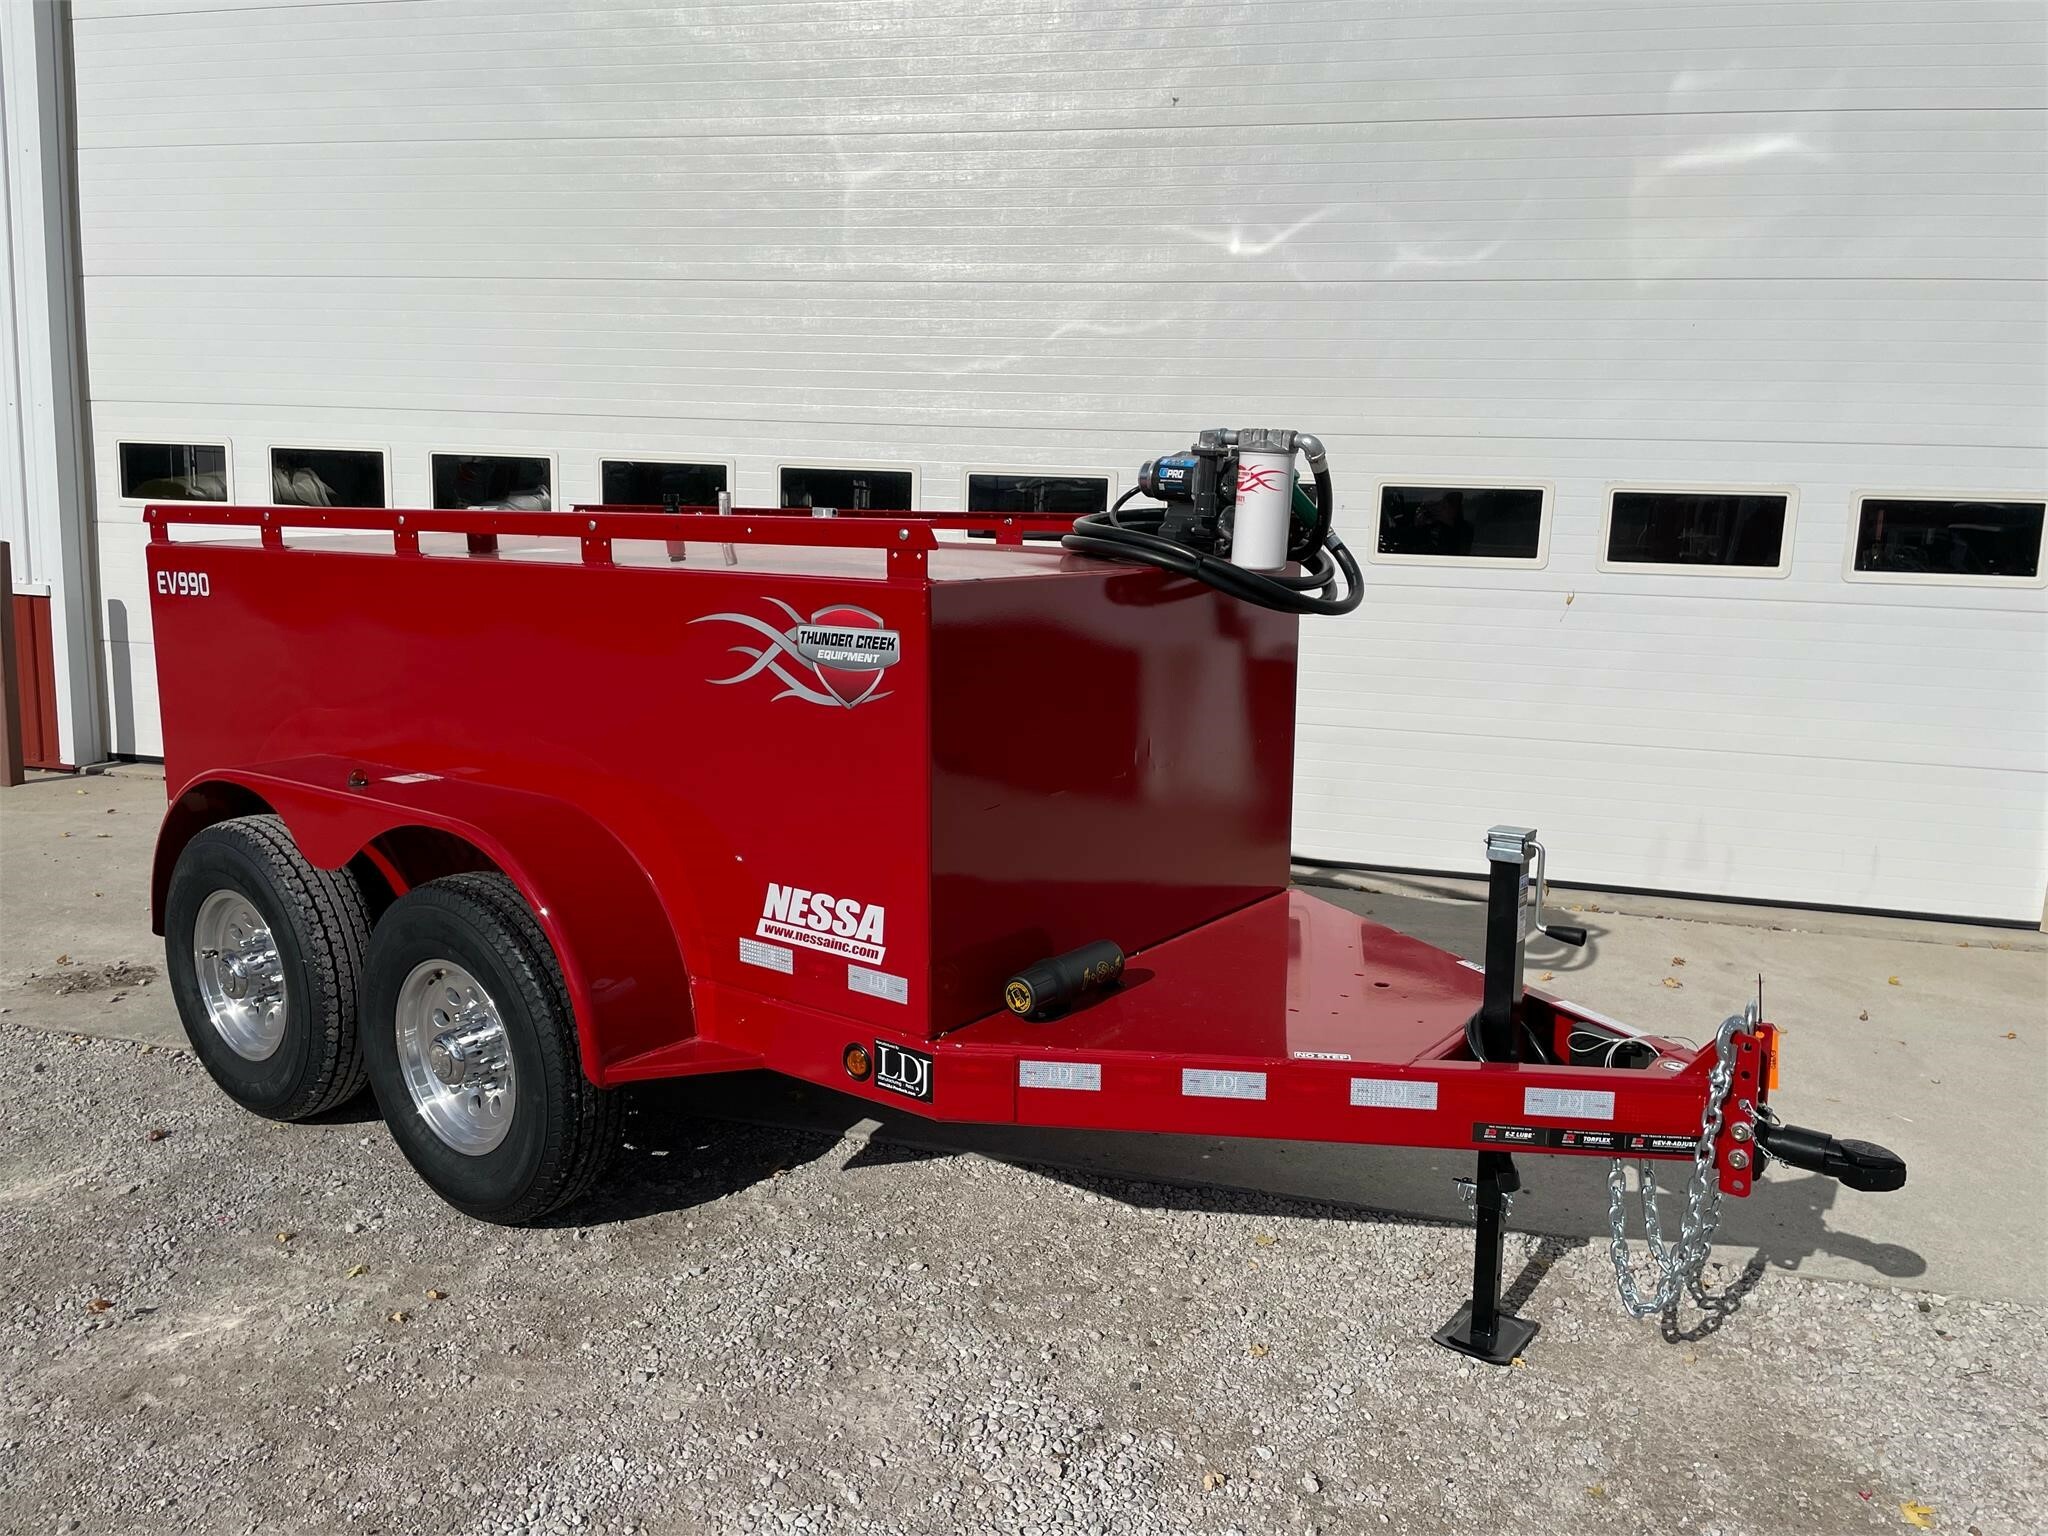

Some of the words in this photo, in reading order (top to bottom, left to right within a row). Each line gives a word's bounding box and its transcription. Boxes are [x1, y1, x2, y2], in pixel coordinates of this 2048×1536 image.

[156, 571, 210, 597] EV990
[799, 630, 853, 649] THUNDER
[856, 635, 898, 652] CREEK
[817, 649, 881, 664] EQUIPMENT
[762, 882, 885, 945] NESSA
[764, 923, 879, 960] www.nessainc.com
[878, 1045, 932, 1097] LDJ
